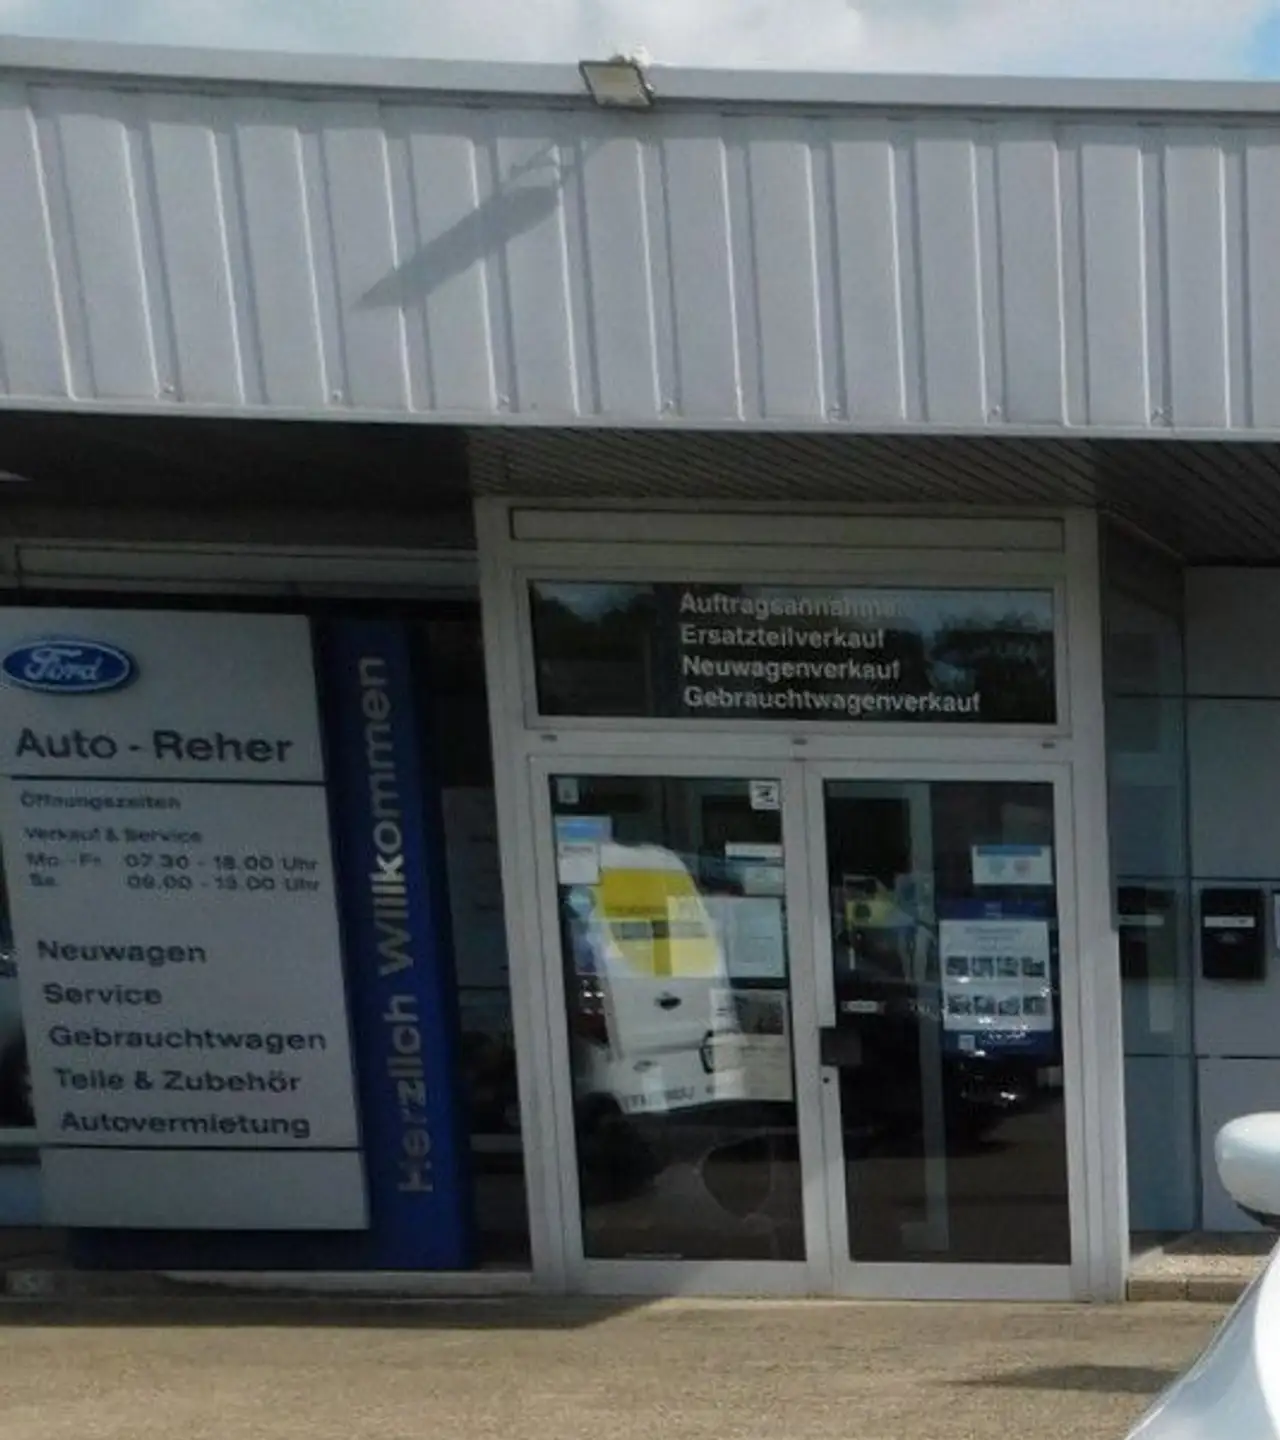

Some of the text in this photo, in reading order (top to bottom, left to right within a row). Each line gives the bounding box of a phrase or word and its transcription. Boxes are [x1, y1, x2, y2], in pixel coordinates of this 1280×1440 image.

[680, 624, 886, 649] Ersatzteilverkauf
[23, 646, 103, 682] Ford
[682, 656, 902, 683] Neuwagenverkauf
[683, 686, 982, 715] Gebrauchtwagenverkauf
[16, 728, 118, 759] Auto
[153, 729, 295, 763] Reher
[24, 826, 101, 843] Verkauf
[123, 828, 203, 844] Service
[281, 857, 318, 872] Uhr
[284, 878, 320, 893] Uhr
[358, 656, 434, 1193] Herzlich Willkommen
[37, 939, 206, 967] Neuwagen
[43, 982, 163, 1006] Service
[48, 1025, 328, 1054] Gebrauchtwagen
[54, 1066, 302, 1093] Teile & Zubehör
[60, 1111, 311, 1138] Autovermietung
